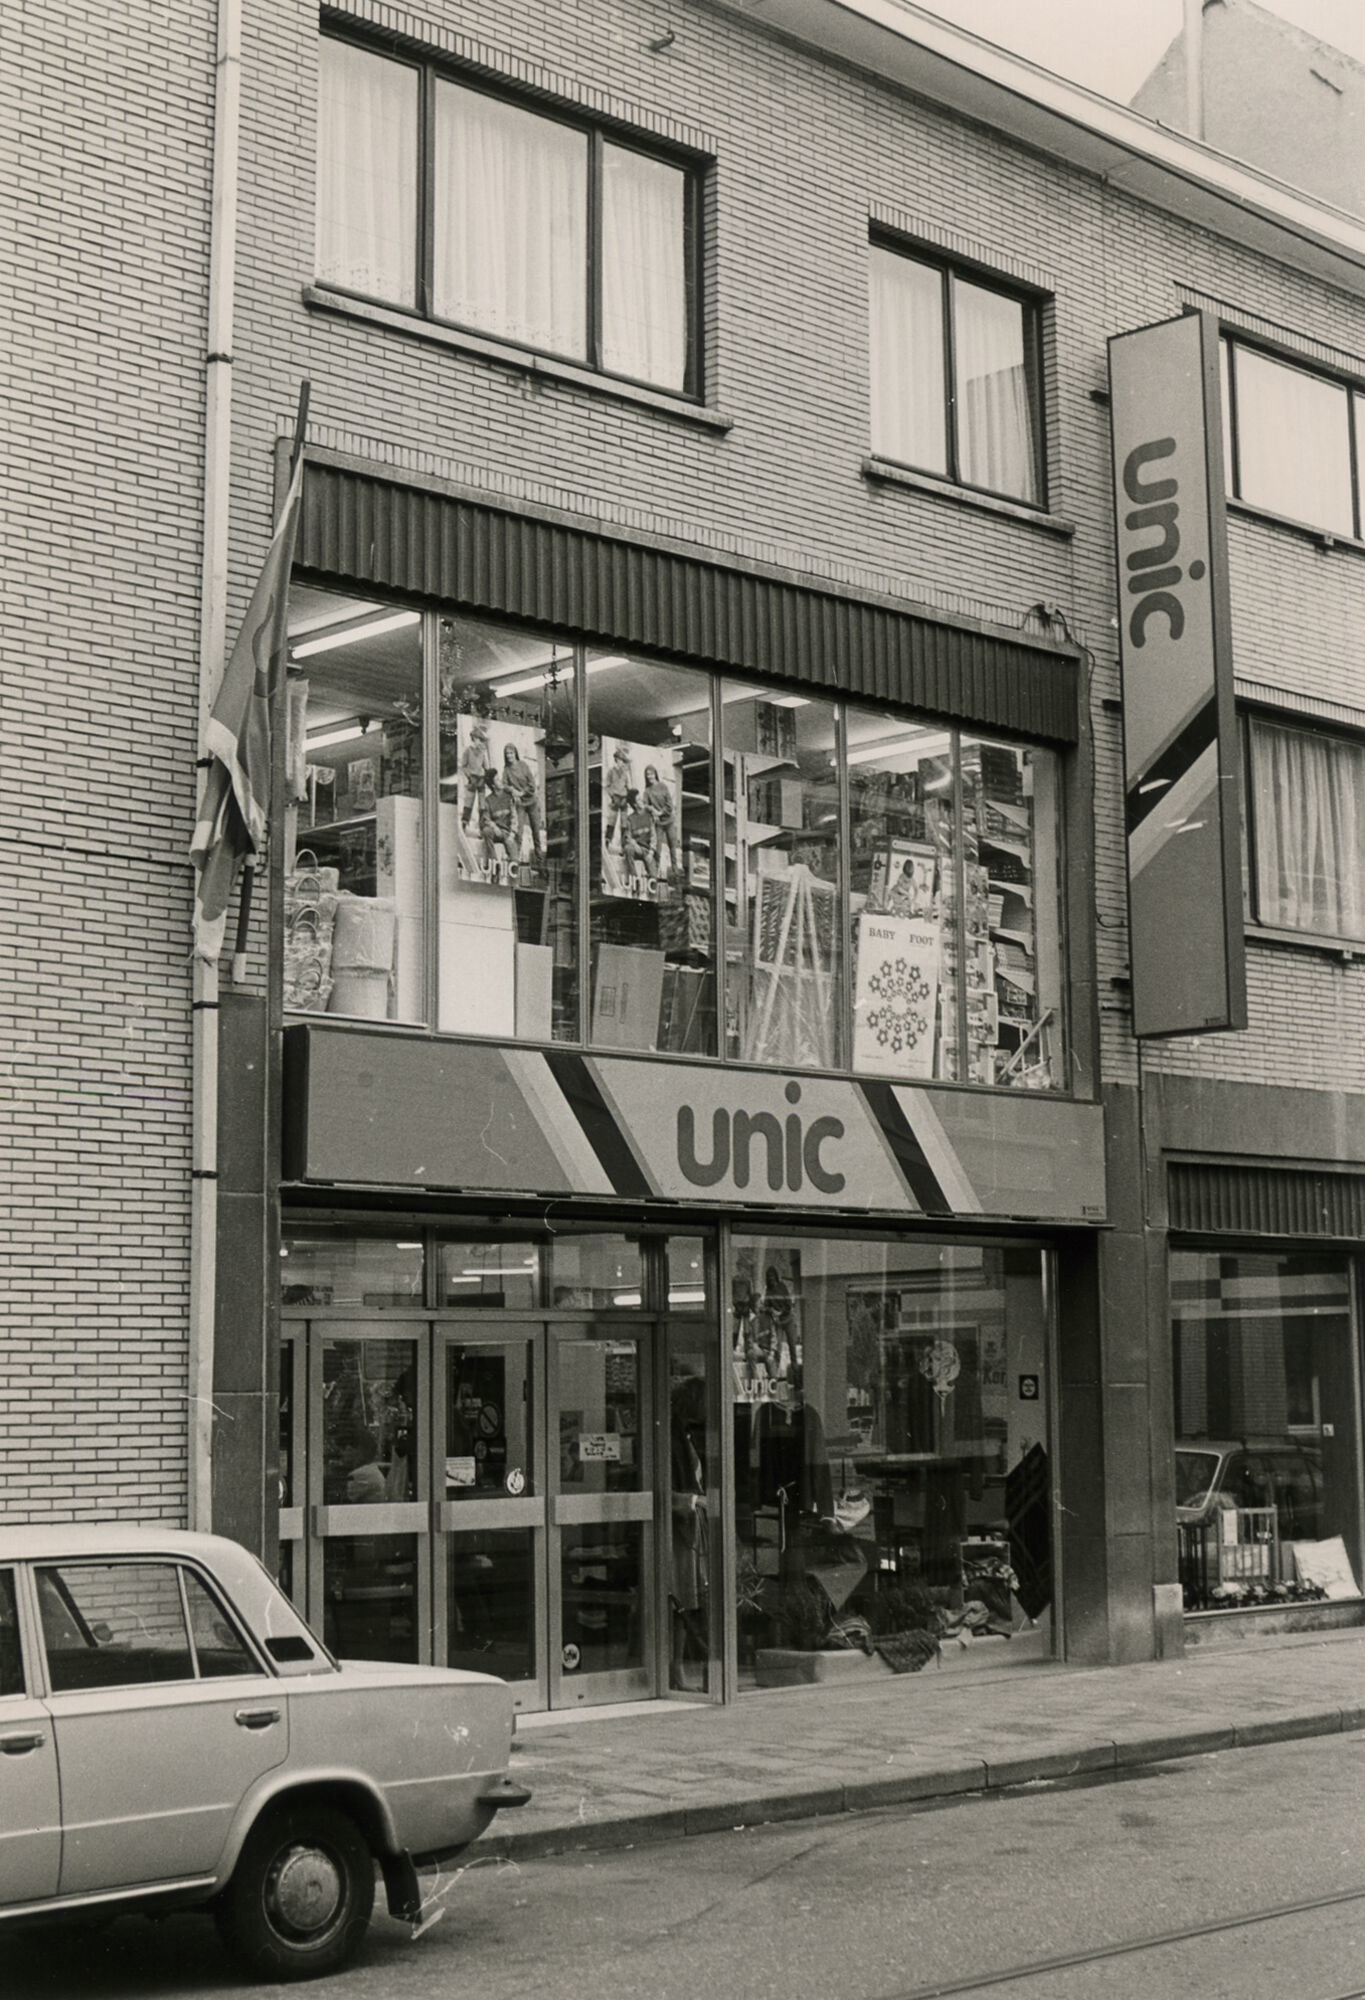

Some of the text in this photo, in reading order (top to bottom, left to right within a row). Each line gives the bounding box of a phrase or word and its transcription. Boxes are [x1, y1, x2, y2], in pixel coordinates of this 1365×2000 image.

[1123, 436, 1205, 648] unic
[480, 857, 519, 878] unic
[621, 873, 657, 894] unic
[869, 927, 935, 946] BABY FOOT
[677, 1080, 846, 1194] unic
[745, 1378, 777, 1394] unic
